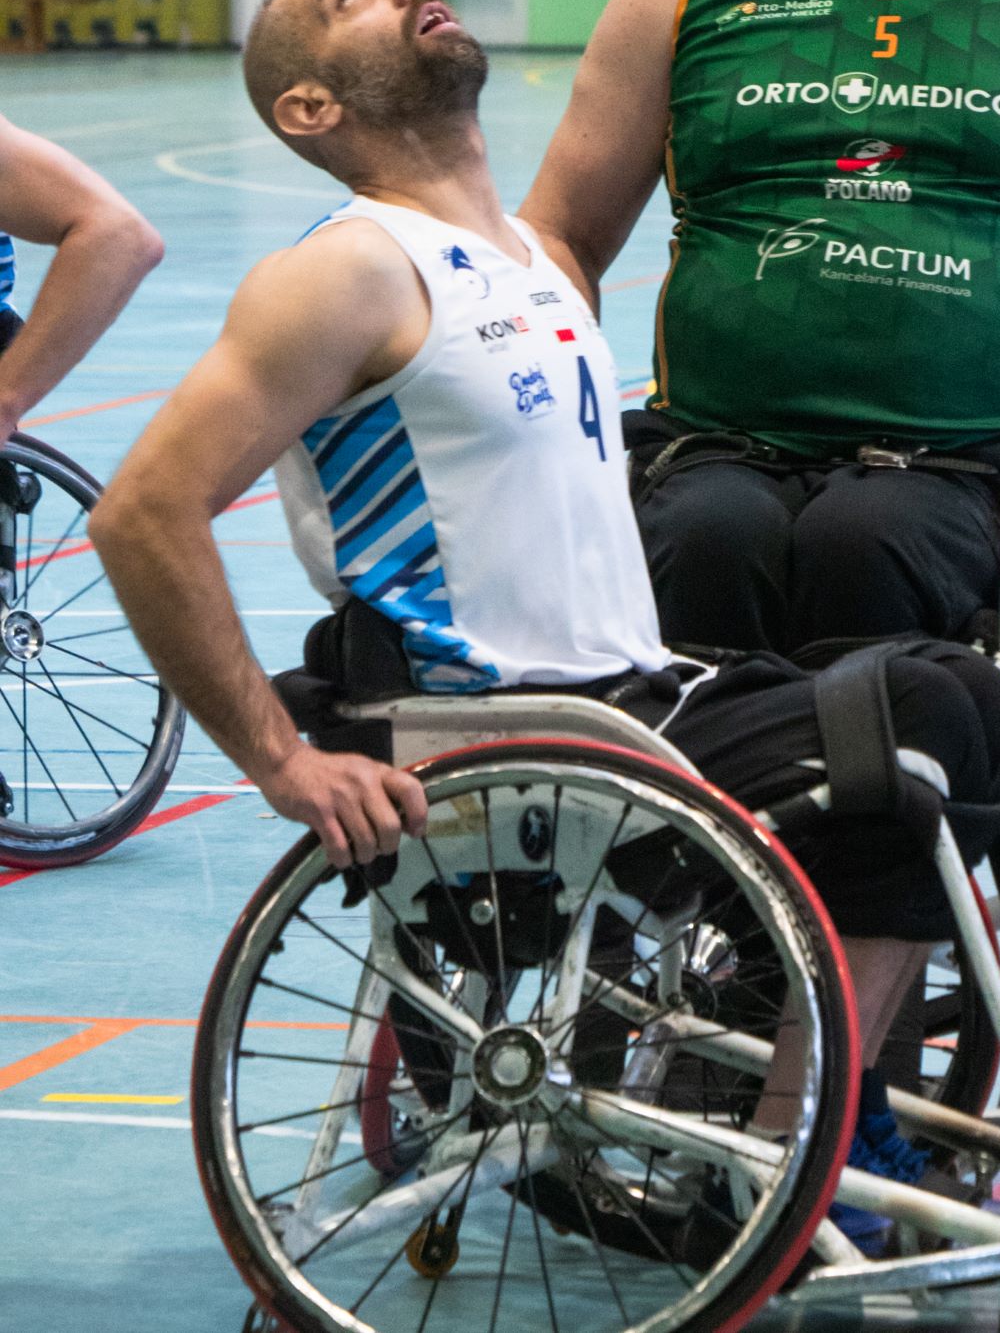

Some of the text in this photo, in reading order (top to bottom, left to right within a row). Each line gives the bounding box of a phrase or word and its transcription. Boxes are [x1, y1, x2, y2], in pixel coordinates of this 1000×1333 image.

[872, 16, 902, 58] 5
[736, 82, 830, 107] ORTO
[825, 181, 912, 202] POLAND
[823, 240, 971, 281] PACTUM
[820, 268, 972, 297] Kancelaria Finansowa
[577, 355, 606, 462] 4
